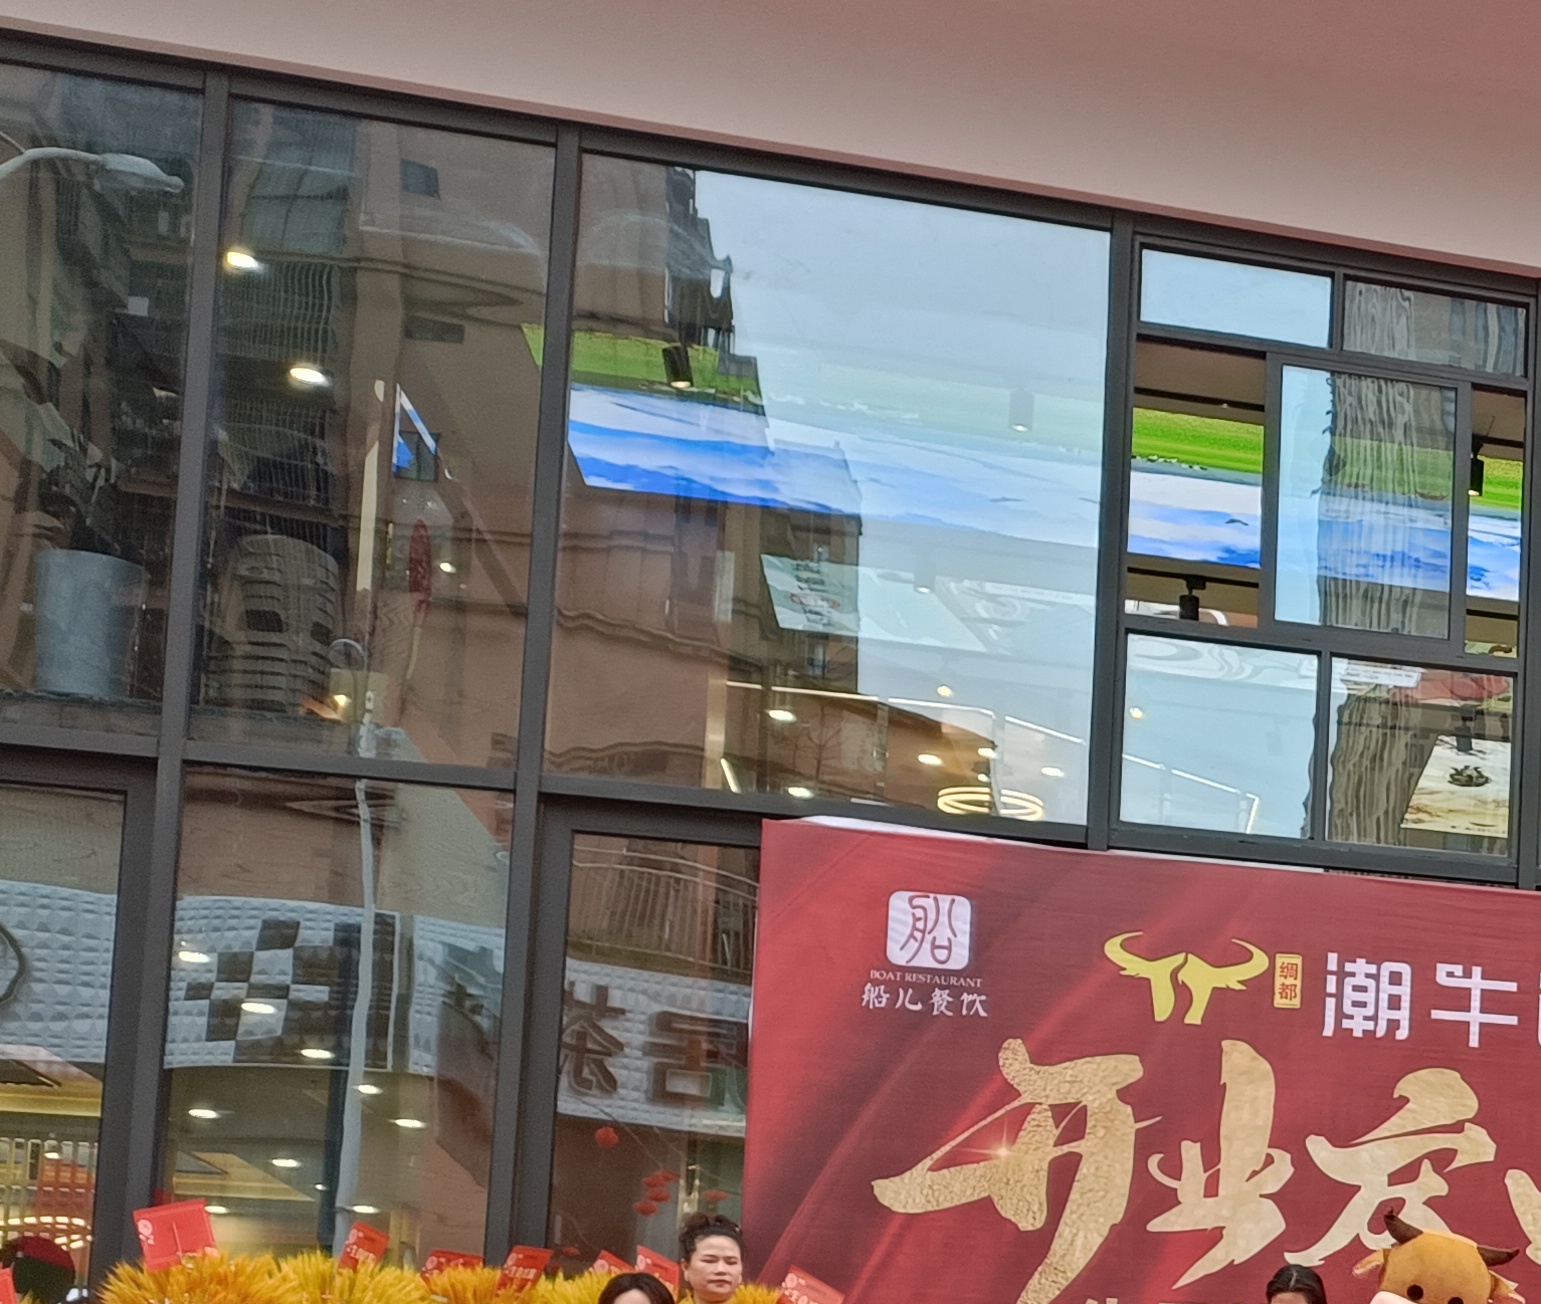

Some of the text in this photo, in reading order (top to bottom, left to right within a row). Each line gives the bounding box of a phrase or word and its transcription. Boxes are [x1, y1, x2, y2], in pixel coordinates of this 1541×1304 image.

[870, 970, 983, 988] BOAT RESTAURANT
[861, 982, 989, 1018] 船儿餐饮
